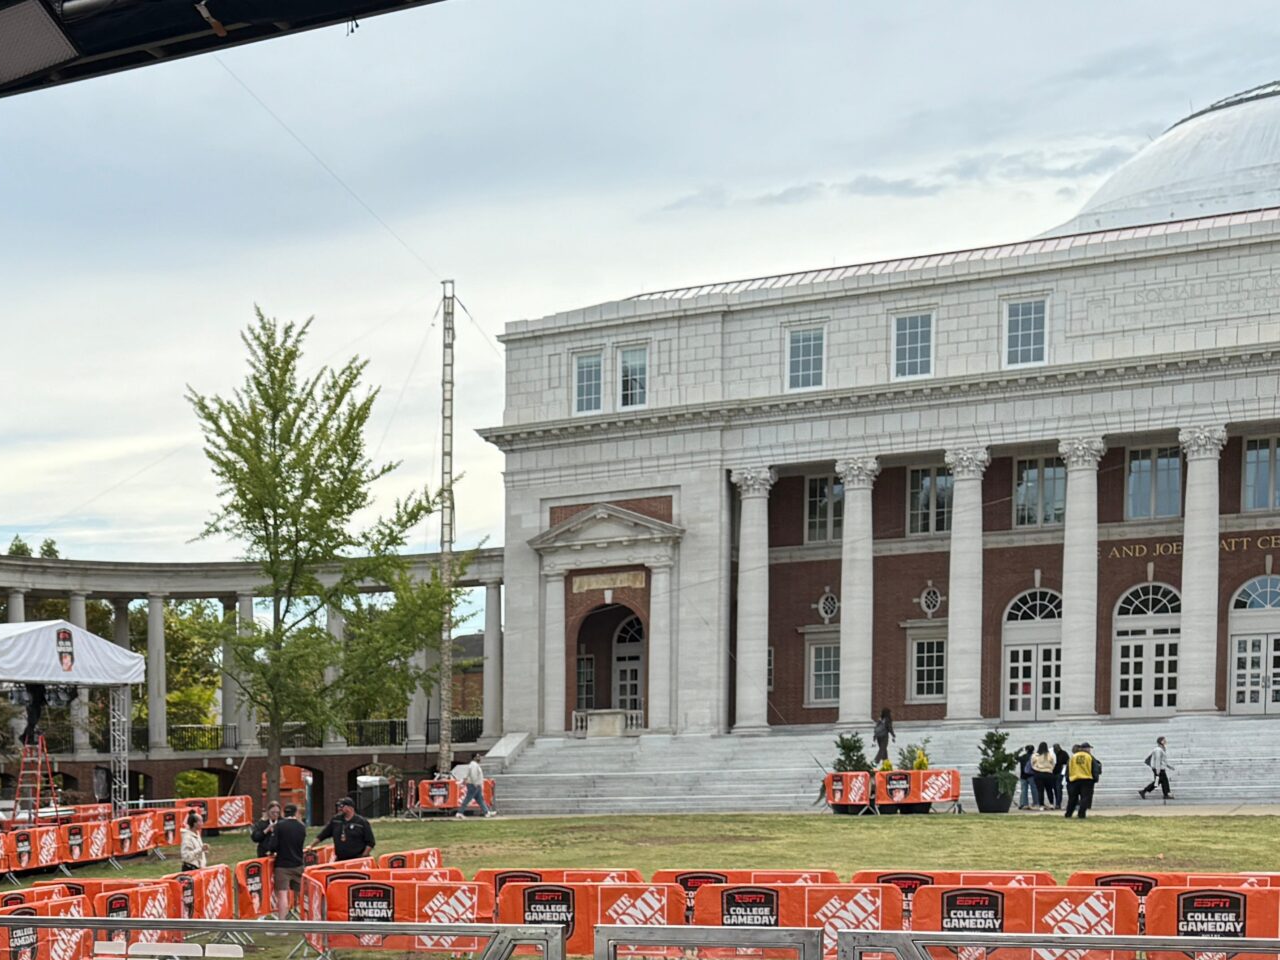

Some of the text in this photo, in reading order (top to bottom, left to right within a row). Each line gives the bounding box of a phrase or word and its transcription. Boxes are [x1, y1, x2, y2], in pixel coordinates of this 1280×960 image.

[1108, 543, 1148, 558] AND
[1152, 541, 1183, 556] JOE
[358, 889, 384, 898] ESPN
[534, 891, 562, 902] ESPN
[734, 893, 766, 903] ESPN
[354, 901, 388, 909] COLLEGE
[422, 891, 448, 916] THE
[615, 886, 667, 925] OME
[956, 896, 990, 906] ESPN
[1193, 898, 1231, 908] ESPN
[530, 904, 568, 912] COLLEGE
[606, 893, 635, 921] THE
[729, 907, 771, 915] COLLEGE
[813, 895, 845, 922] THE
[348, 908, 393, 918] GAMEDAY
[524, 911, 574, 922] GAMEDAY
[950, 909, 995, 919] COLLEGE
[1041, 898, 1076, 927] THE
[1186, 912, 1236, 922] COLLEGE
[723, 915, 777, 925] GAMEDAY
[942, 918, 1002, 929] GAMEDAY
[1178, 921, 1244, 933] GAMEDAY
[9, 934, 37, 947] GAMEDAY
